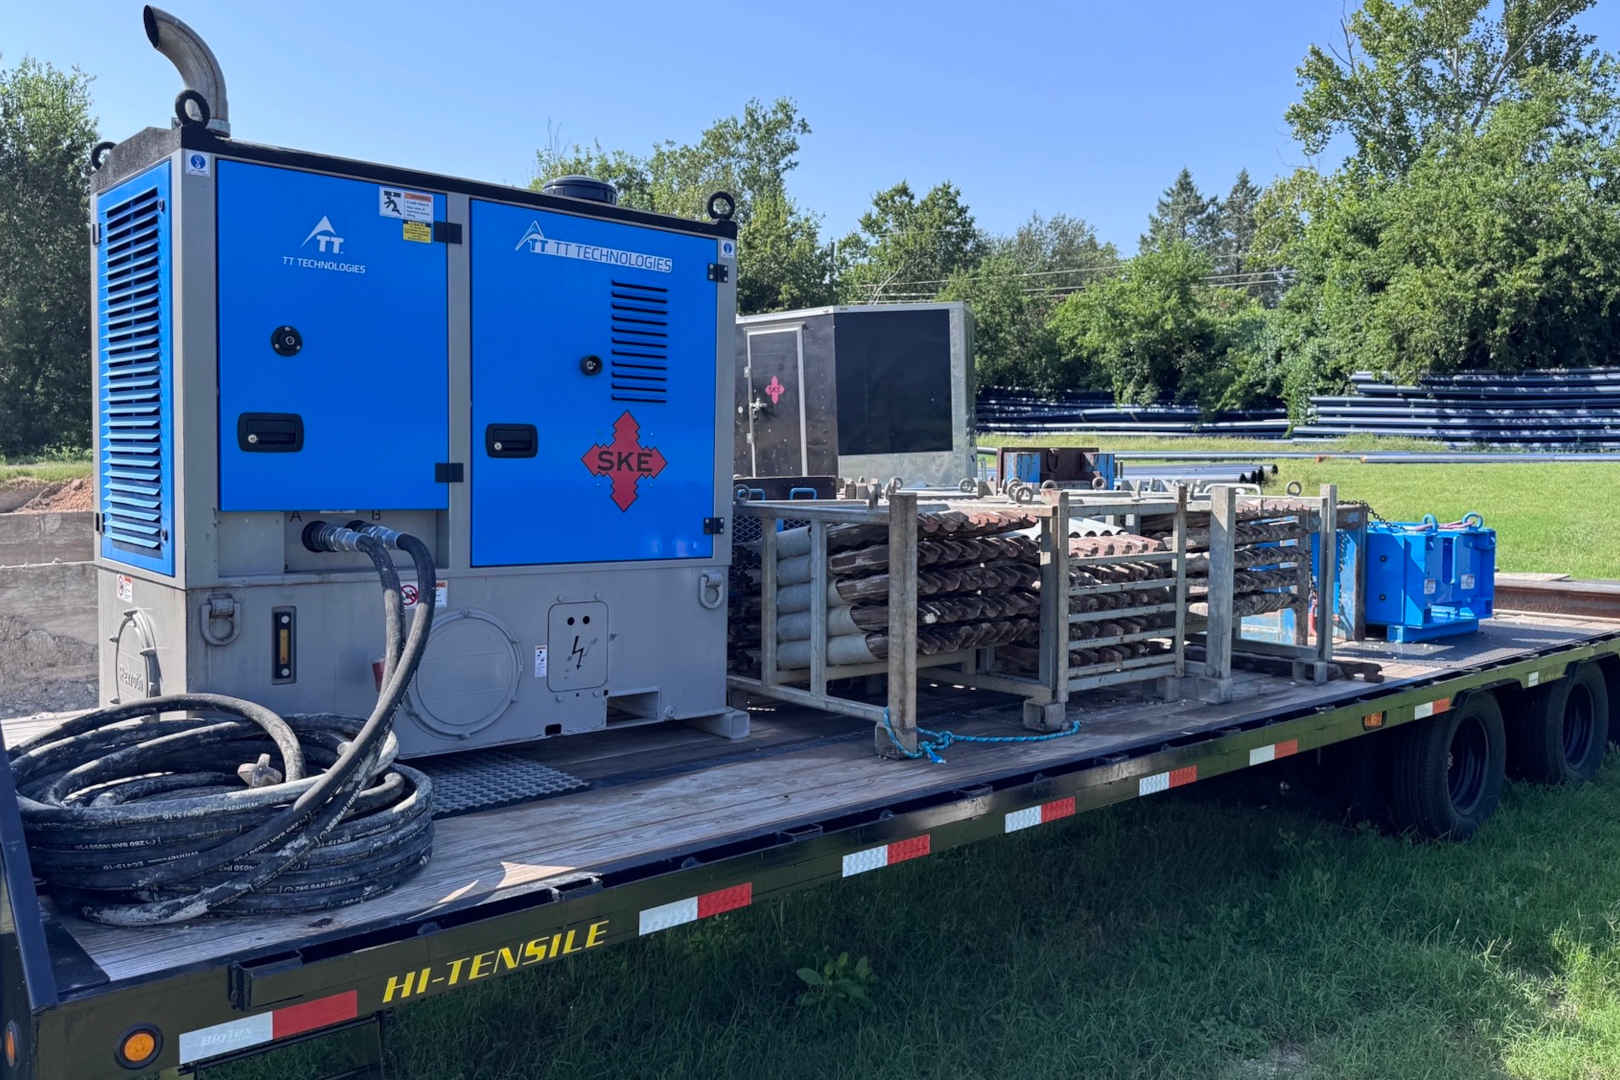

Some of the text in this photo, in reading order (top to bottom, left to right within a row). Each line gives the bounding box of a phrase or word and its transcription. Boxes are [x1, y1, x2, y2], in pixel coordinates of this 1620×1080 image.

[282, 256, 367, 274] TT TECHNOLOGIES
[554, 241, 574, 256] TT
[576, 245, 672, 273] TECHNOLOGIES
[597, 450, 653, 472] SKE
[382, 920, 610, 1004] HI-TENSILE
